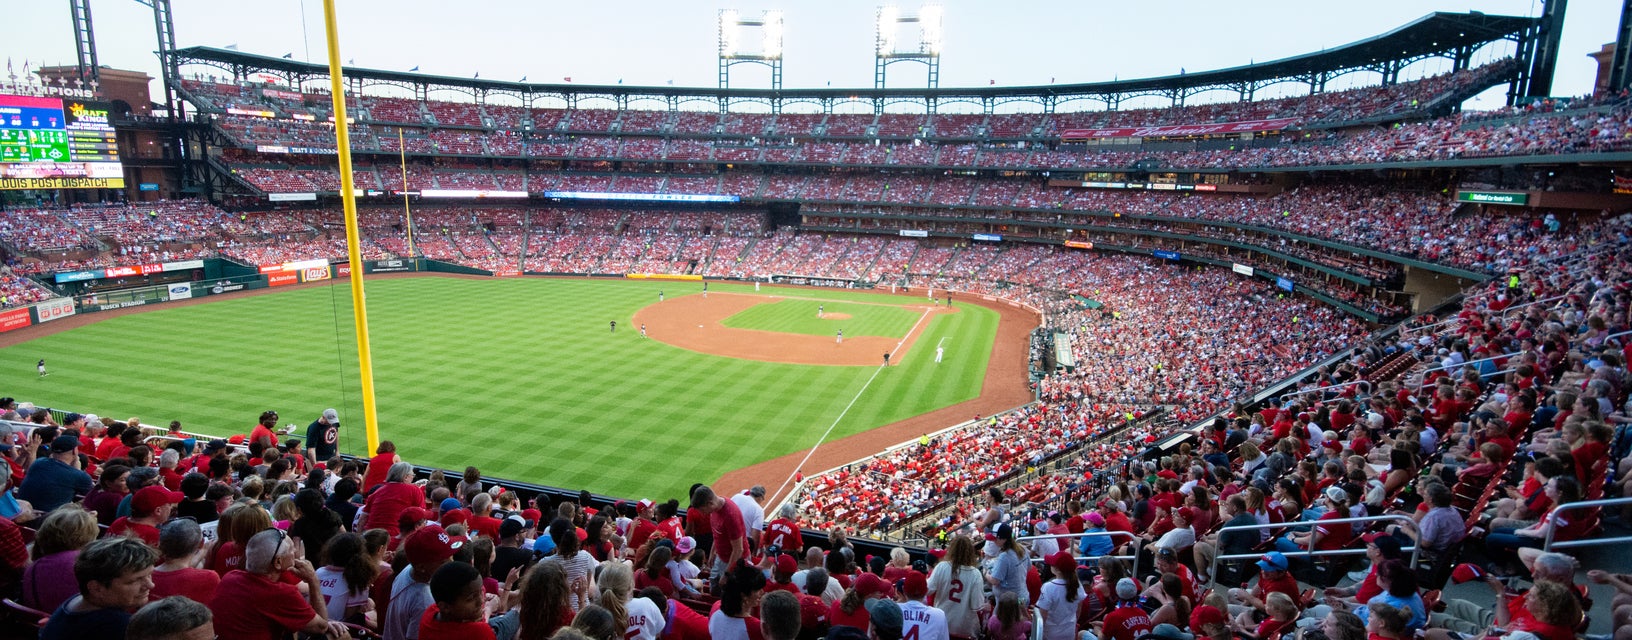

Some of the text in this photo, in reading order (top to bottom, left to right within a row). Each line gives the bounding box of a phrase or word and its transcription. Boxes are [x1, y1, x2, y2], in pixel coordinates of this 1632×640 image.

[3, 82, 94, 98] CHAMPIONS
[73, 109, 108, 117] DRAFT
[78, 115, 108, 123] KINGS
[31, 178, 108, 188] POST-DISPATCH
[100, 300, 146, 311] BUSCH STADIUM
[773, 533, 785, 549] 4
[948, 578, 964, 604] 2
[903, 609, 931, 625] OLINA
